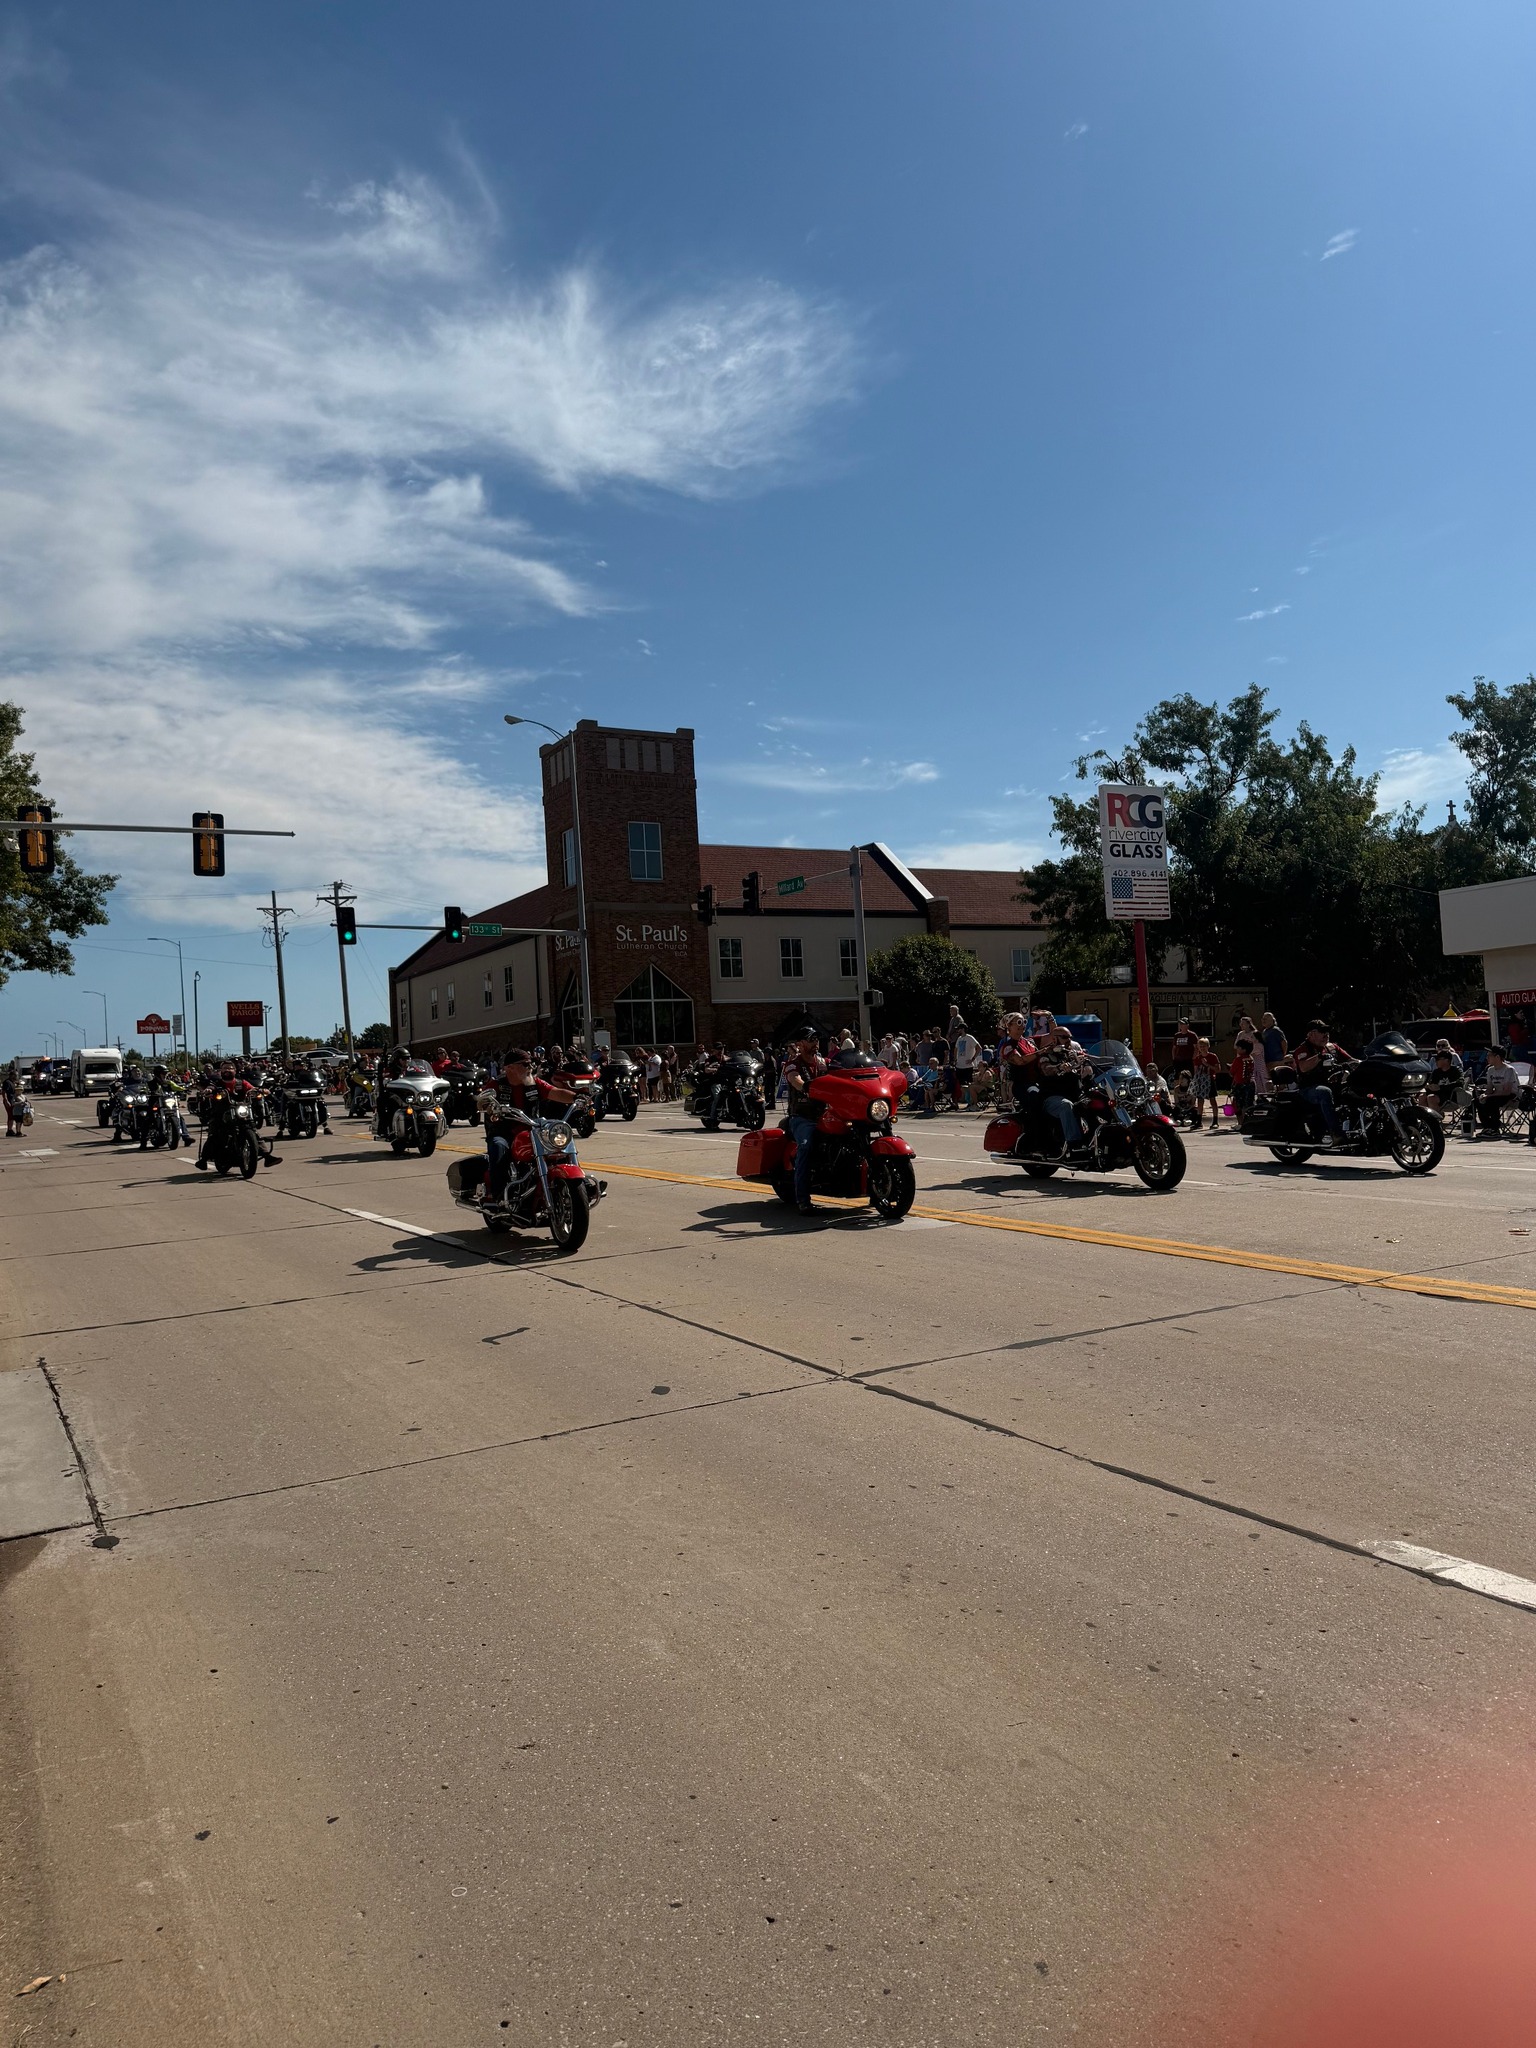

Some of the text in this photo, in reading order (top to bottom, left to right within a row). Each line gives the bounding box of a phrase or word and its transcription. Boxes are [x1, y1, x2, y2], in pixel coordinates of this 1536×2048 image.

[1107, 793, 1163, 828] RCG
[1109, 828, 1163, 841] rivercity
[1110, 844, 1163, 858] GLASS
[1112, 870, 1167, 878] 402.896.4141
[492, 926, 501, 934] St
[616, 924, 688, 942] St. Paul's
[1150, 994, 1228, 1003] AQUERIA LA BARCA
[1501, 993, 1520, 1004] AUTO
